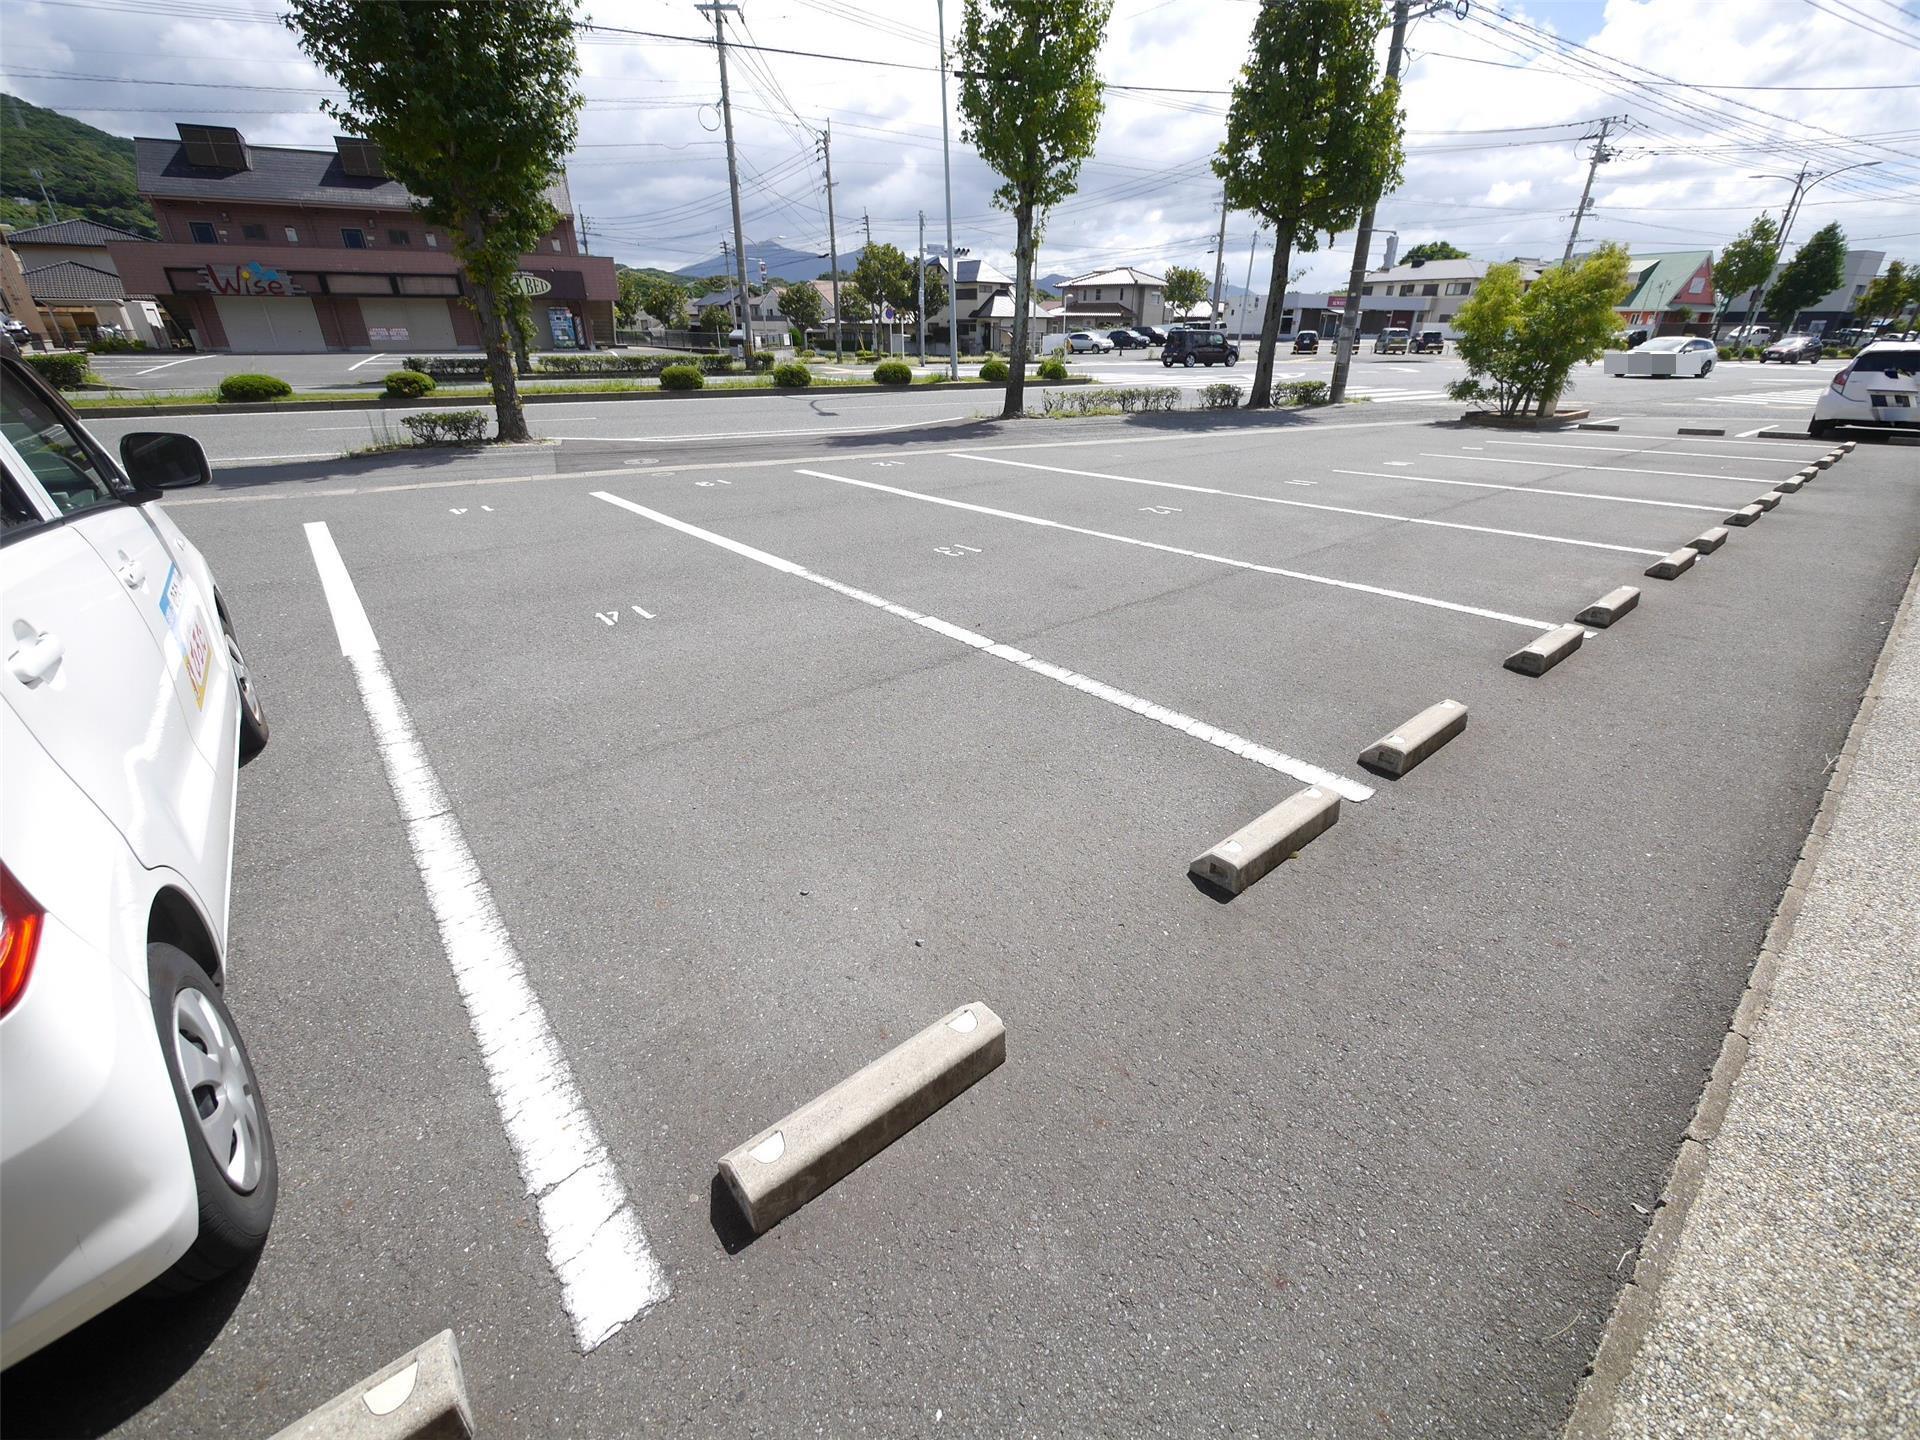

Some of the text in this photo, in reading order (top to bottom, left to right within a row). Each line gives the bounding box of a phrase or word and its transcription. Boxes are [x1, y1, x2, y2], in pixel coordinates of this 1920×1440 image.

[206, 264, 285, 295] Wise
[525, 277, 549, 294] BED
[1138, 505, 1183, 515] 12
[933, 544, 983, 557] 13
[595, 605, 657, 626] 14
